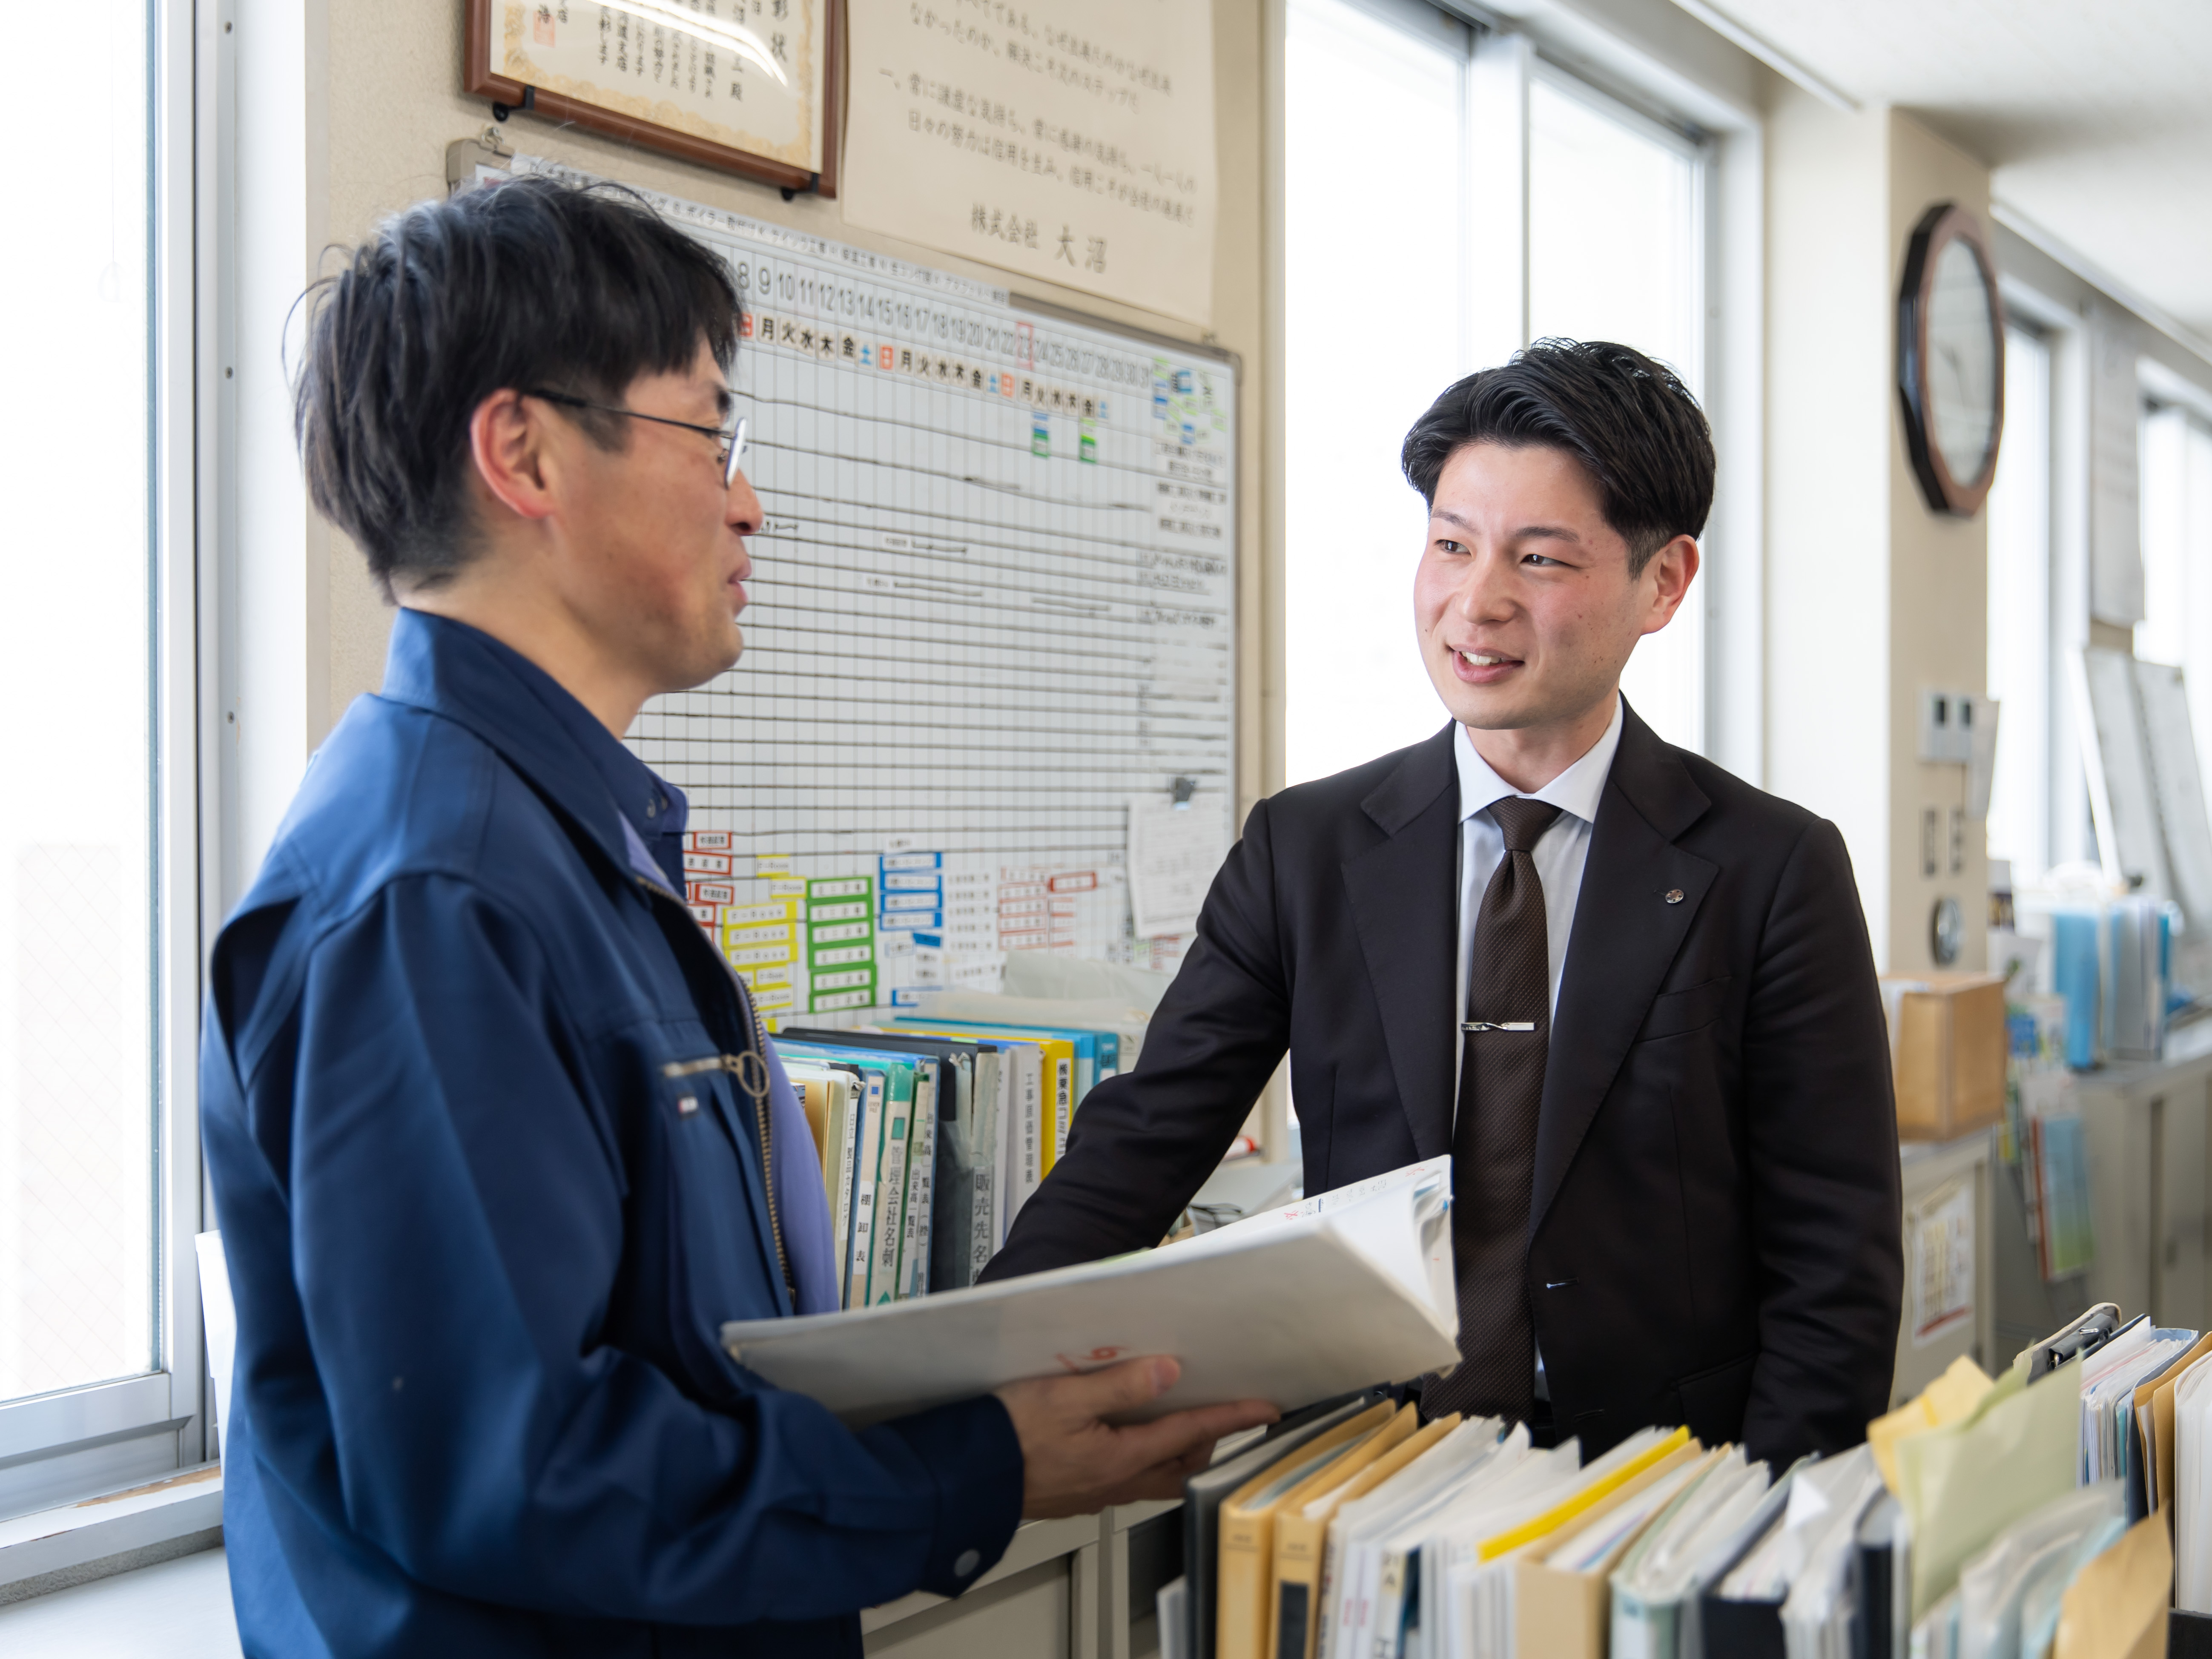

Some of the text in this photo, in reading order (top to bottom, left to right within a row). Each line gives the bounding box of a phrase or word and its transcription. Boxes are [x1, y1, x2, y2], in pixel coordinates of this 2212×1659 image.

[970, 202, 1039, 250] 株式会社
[738, 261, 750, 290] 8
[759, 267, 771, 295] 9
[779, 273, 795, 300] 10
[799, 278, 814, 306] 11
[819, 283, 835, 311] 12
[839, 288, 855, 316] 13
[858, 293, 874, 320] 14
[878, 297, 894, 325] 15
[896, 303, 912, 330] 16
[915, 307, 930, 333] 17
[932, 312, 949, 339] 18
[951, 317, 966, 344] 19
[967, 321, 983, 347] 20
[985, 326, 999, 351] 21
[1001, 330, 1016, 356] 22
[740, 313, 752, 337] 日
[761, 317, 774, 340] 月
[782, 322, 796, 343] 火
[800, 327, 814, 349] 水
[821, 336, 833, 356] 木
[842, 336, 855, 357] 金
[859, 343, 872, 365] 土
[879, 345, 894, 370] 日
[900, 350, 912, 372] 月
[917, 356, 930, 377] 火
[937, 361, 948, 380] 水
[954, 363, 965, 382] 木
[972, 369, 981, 390] 金
[987, 373, 998, 393] 土
[1001, 373, 1015, 397] 日
[882, 1145, 903, 1267] 管理会社名刺
[906, 1168, 920, 1239] 出来高一覧表
